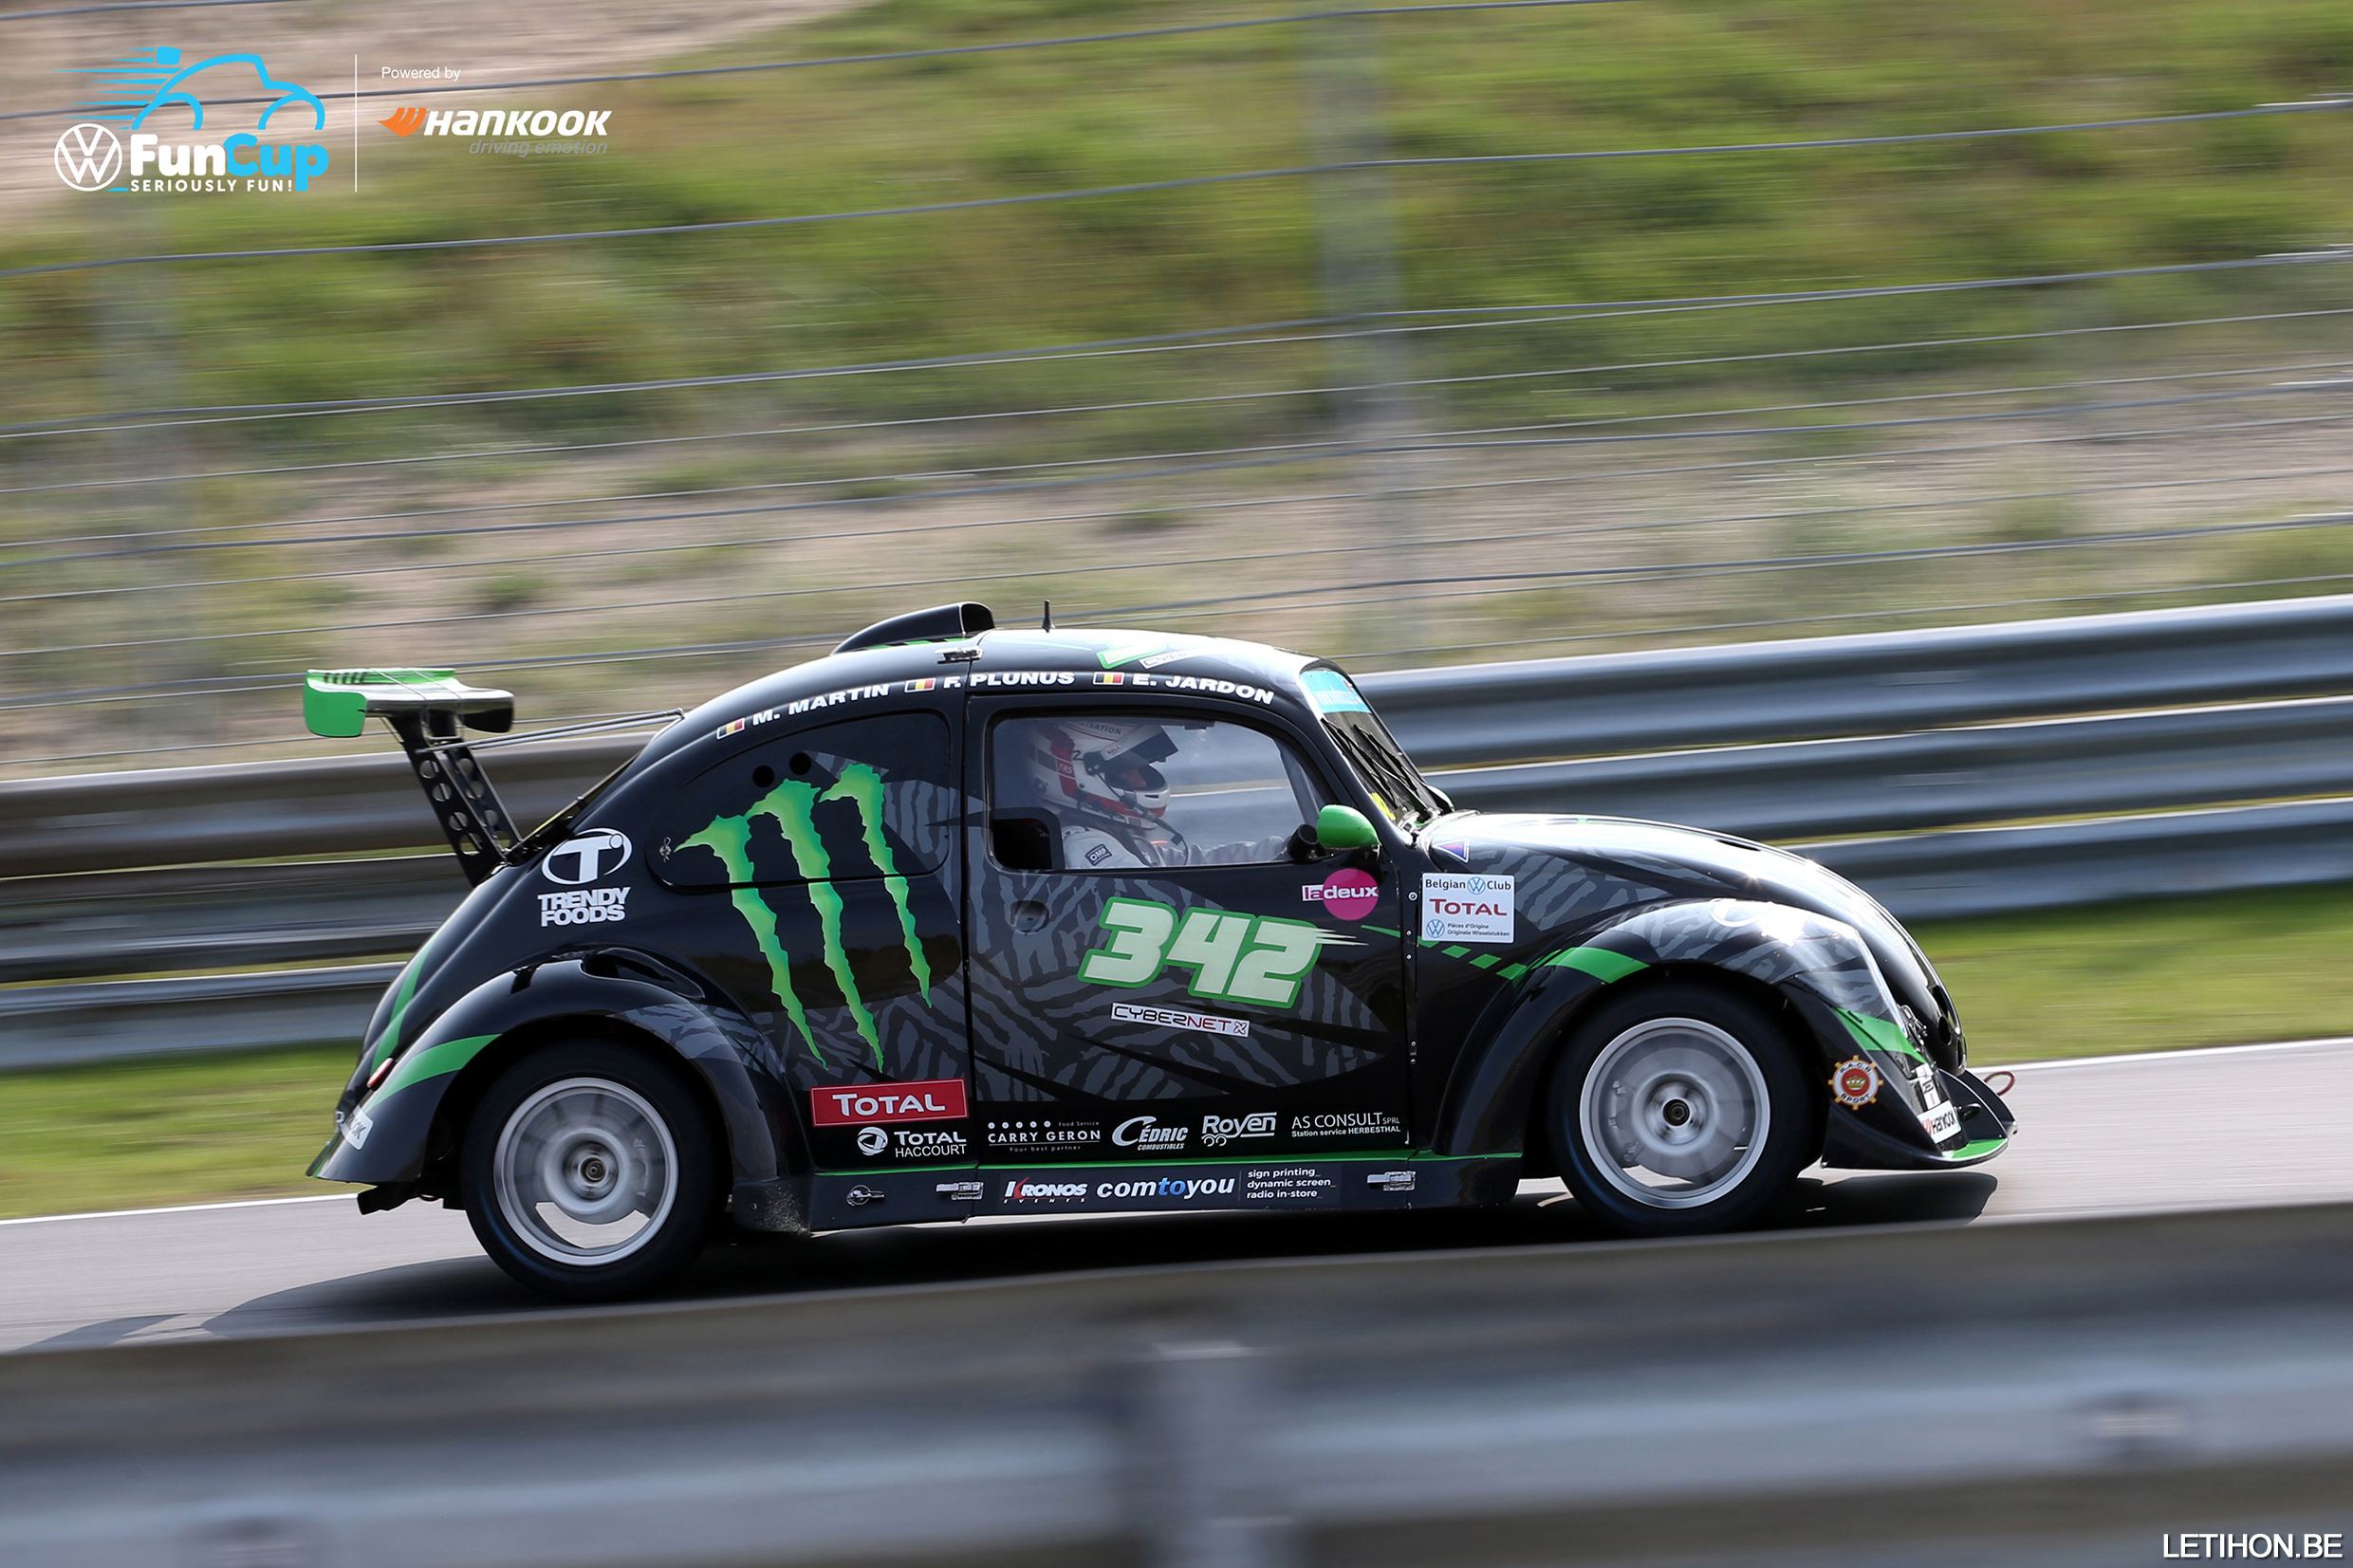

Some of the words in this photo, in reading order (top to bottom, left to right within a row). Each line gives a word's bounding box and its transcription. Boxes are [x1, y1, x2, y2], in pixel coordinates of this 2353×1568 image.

[942, 675, 962, 690] F.
[970, 672, 1076, 688] PLUNUS
[1131, 673, 1158, 688] E.
[1164, 675, 1275, 705] JARDON
[751, 710, 781, 727] M.
[787, 683, 890, 715] MARTIN
[1425, 878, 1466, 891] Belgian
[1487, 880, 1511, 891] Club
[537, 886, 632, 912] TRENDY
[1428, 898, 1508, 916] TOTAL
[540, 904, 626, 928] FOODS
[1078, 896, 1325, 1008] 342
[831, 1093, 947, 1117] TOTAL
[1201, 1111, 1278, 1139] Royen
[1291, 1116, 1311, 1130] AS
[1313, 1112, 1383, 1128] CONSULT
[1382, 1116, 1400, 1125] SPRL
[893, 1130, 968, 1145] TOTAL
[987, 1132, 1039, 1144] CARRY
[1046, 1130, 1102, 1142] GERON
[1291, 1129, 1318, 1138] Station
[1320, 1128, 1347, 1136] service
[1347, 1126, 1401, 1134] HERBESTHAL
[894, 1143, 968, 1158] HACCOURT
[1051, 1144, 1082, 1153] partner
[1137, 1142, 1186, 1151] COMBUSTIBLES
[1247, 1169, 1270, 1179] sign
[1004, 1175, 1088, 1199] KRONOS
[1096, 1176, 1235, 1200] comtoyou
[1247, 1179, 1294, 1190] dynamic
[1247, 1190, 1274, 1199] radio
